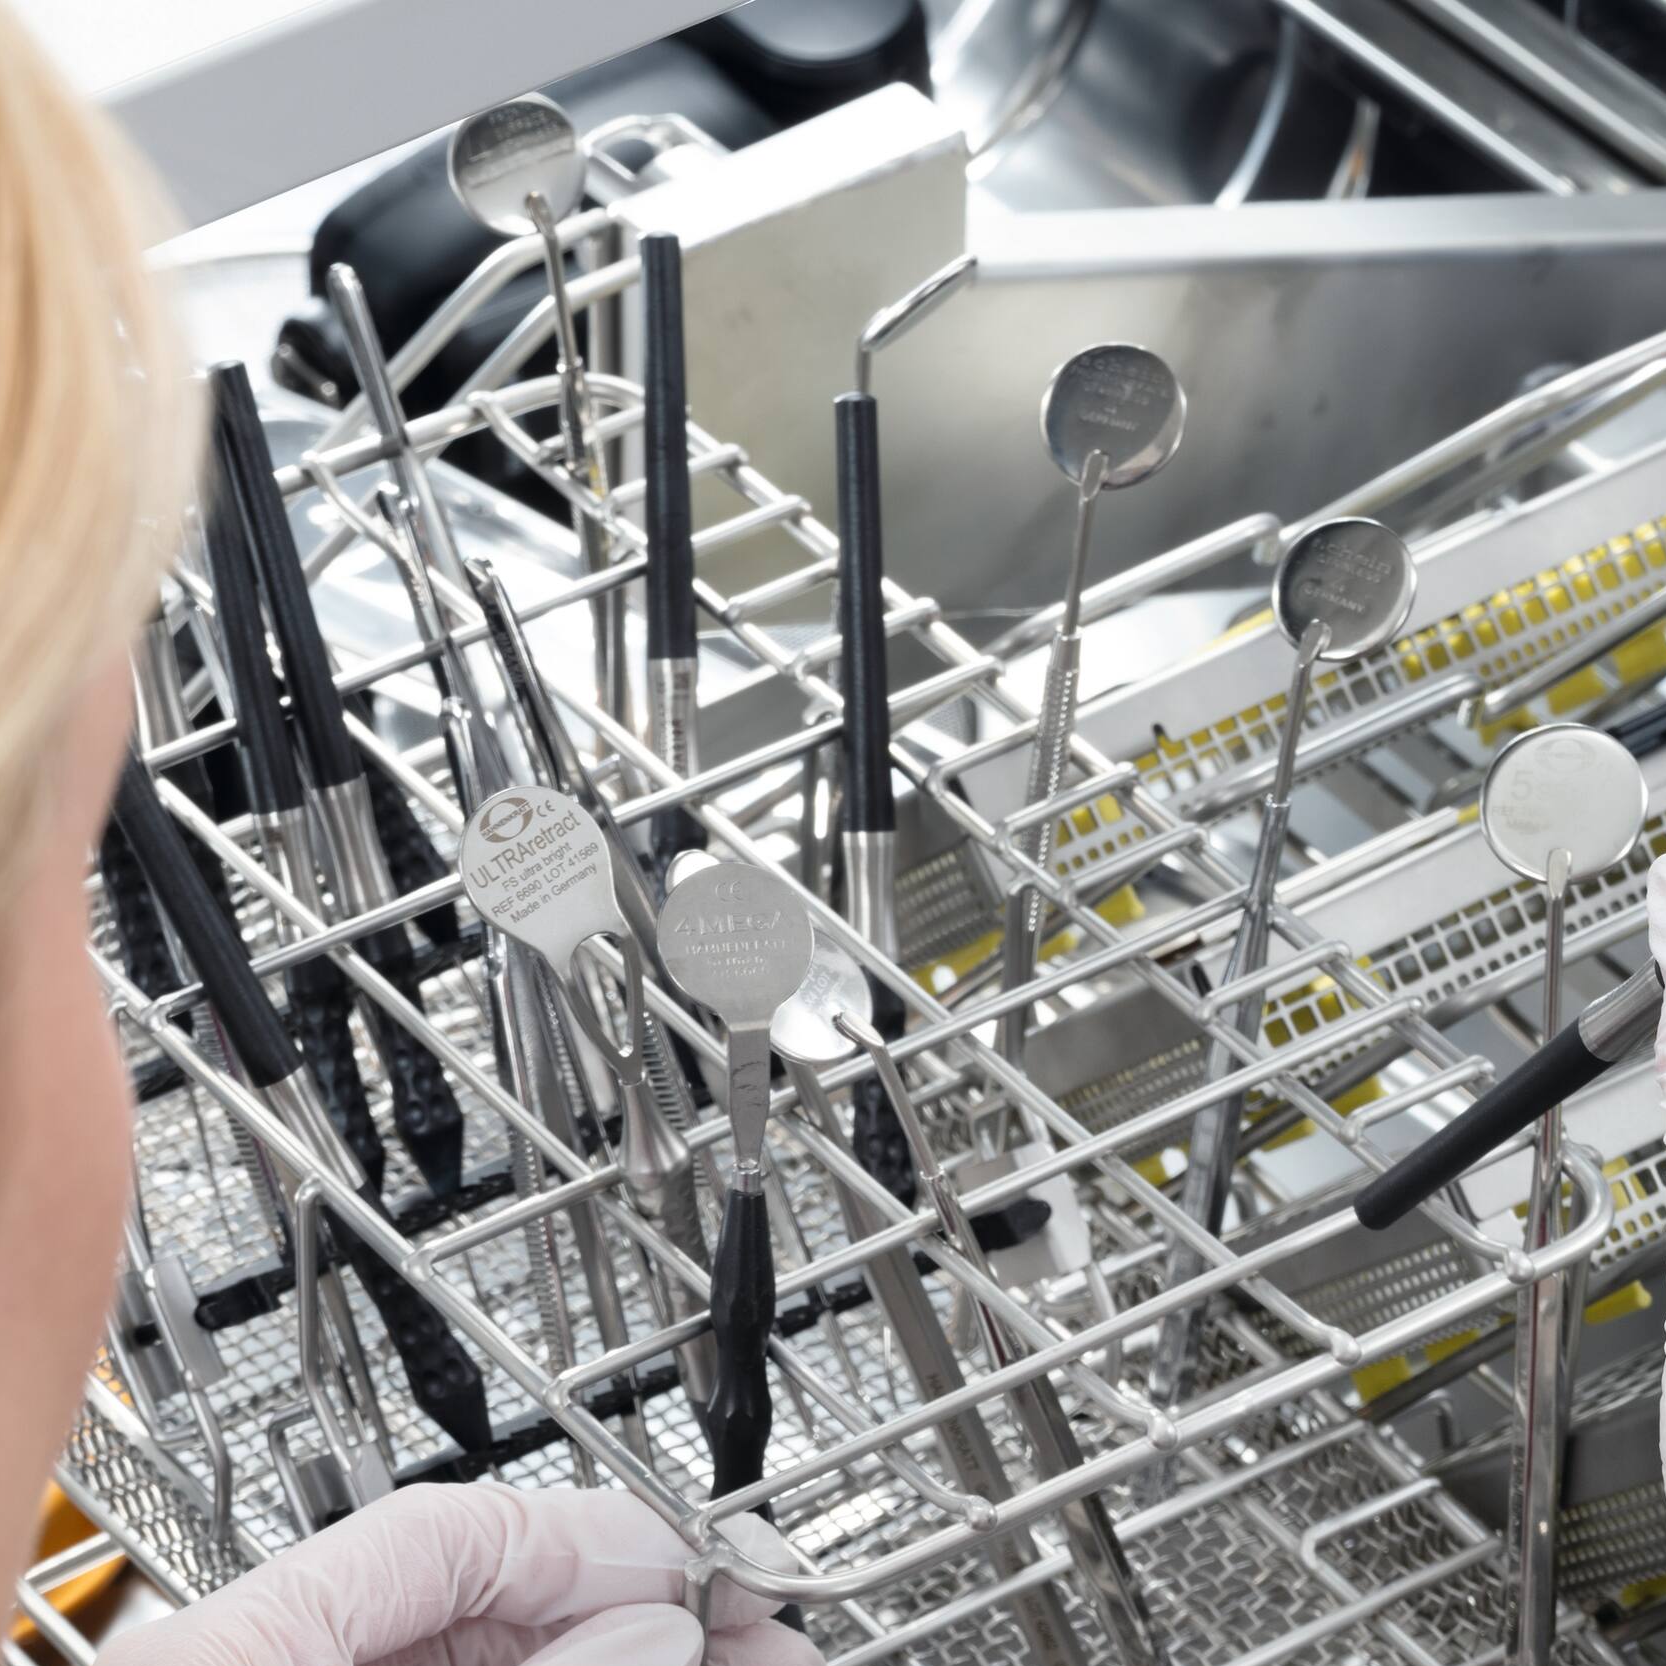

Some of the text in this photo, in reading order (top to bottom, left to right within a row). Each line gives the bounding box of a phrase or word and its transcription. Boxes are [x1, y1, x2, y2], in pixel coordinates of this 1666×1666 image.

[469, 810, 582, 889] ULTRAretract
[491, 842, 600, 918] REF 6690 LOT 41569
[501, 841, 573, 891] FS ultra bright
[510, 862, 598, 924] Made in Germany
